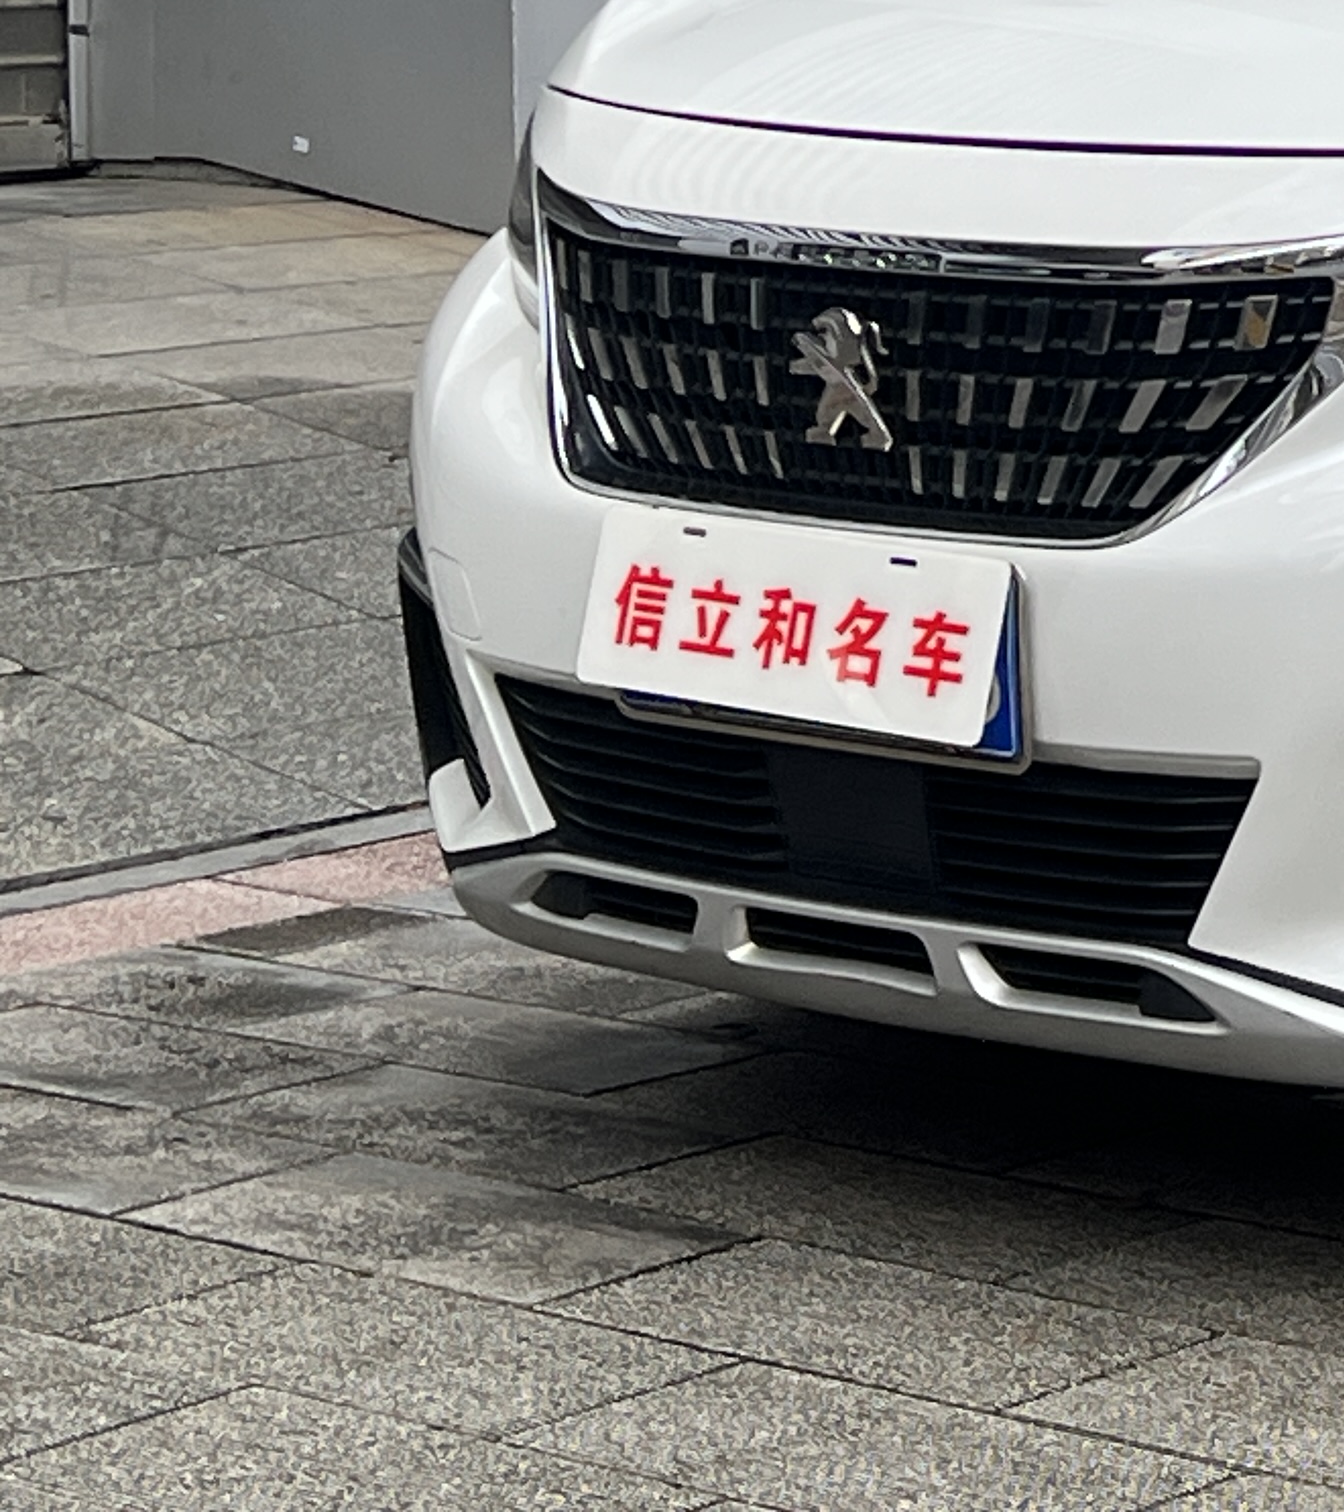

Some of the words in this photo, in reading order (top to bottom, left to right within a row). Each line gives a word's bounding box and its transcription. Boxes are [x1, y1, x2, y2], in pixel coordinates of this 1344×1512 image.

[614, 563, 971, 698] 信立和名车
